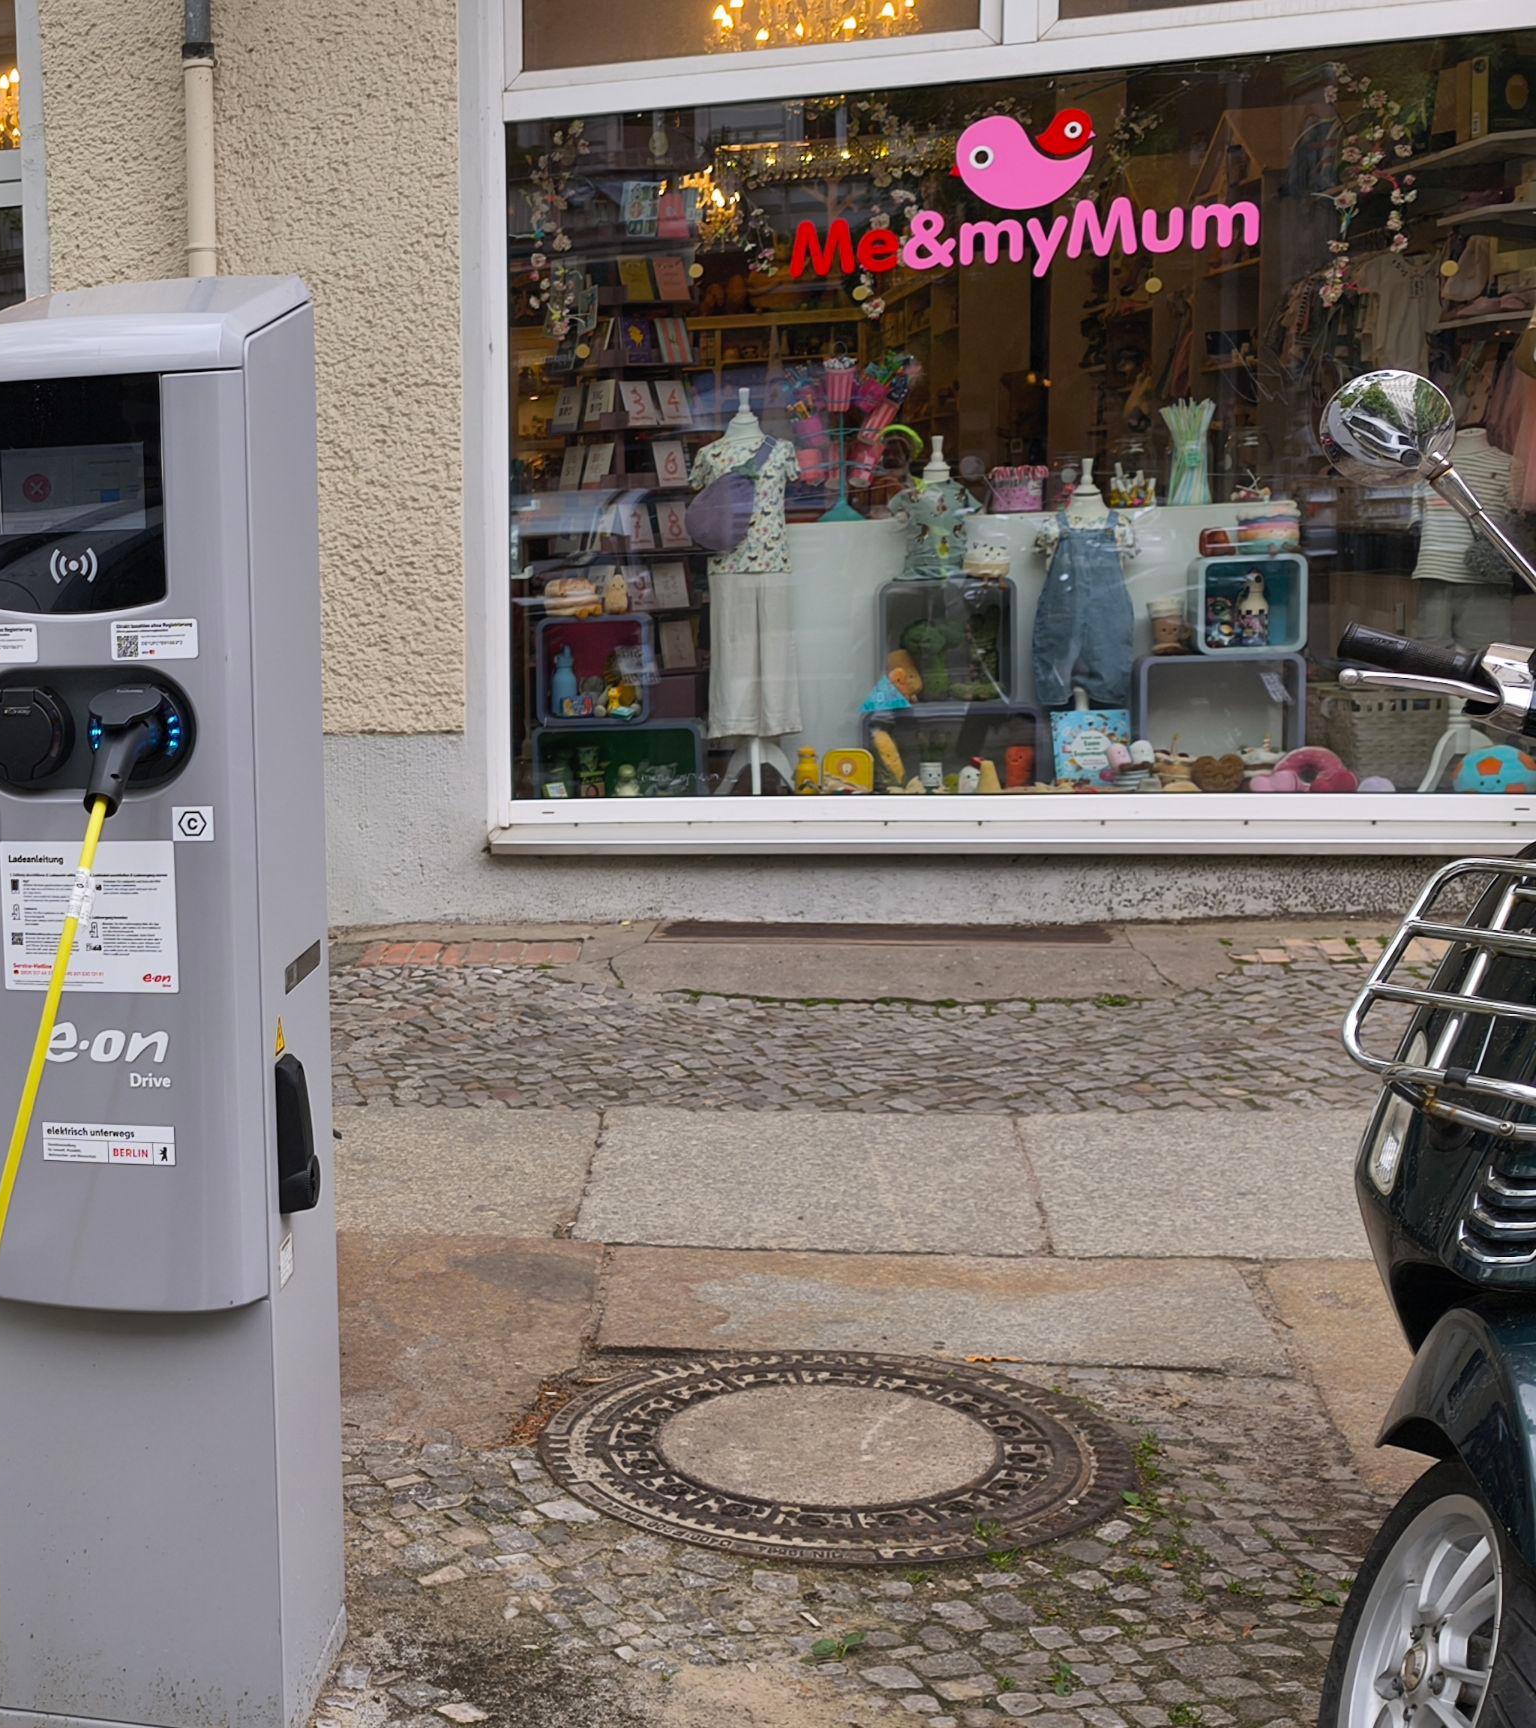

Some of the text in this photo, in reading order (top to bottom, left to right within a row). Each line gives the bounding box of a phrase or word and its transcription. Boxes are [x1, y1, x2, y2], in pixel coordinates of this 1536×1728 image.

[789, 196, 1261, 278] Me&myMum
[666, 387, 681, 413] 4
[664, 450, 678, 475] 6
[187, 818, 198, 830] C
[8, 854, 64, 865] Ladeanleitung
[129, 1072, 172, 1088] Drive
[46, 1126, 135, 1140] elektrisch unterwegs
[112, 1147, 149, 1159] BERLIN
